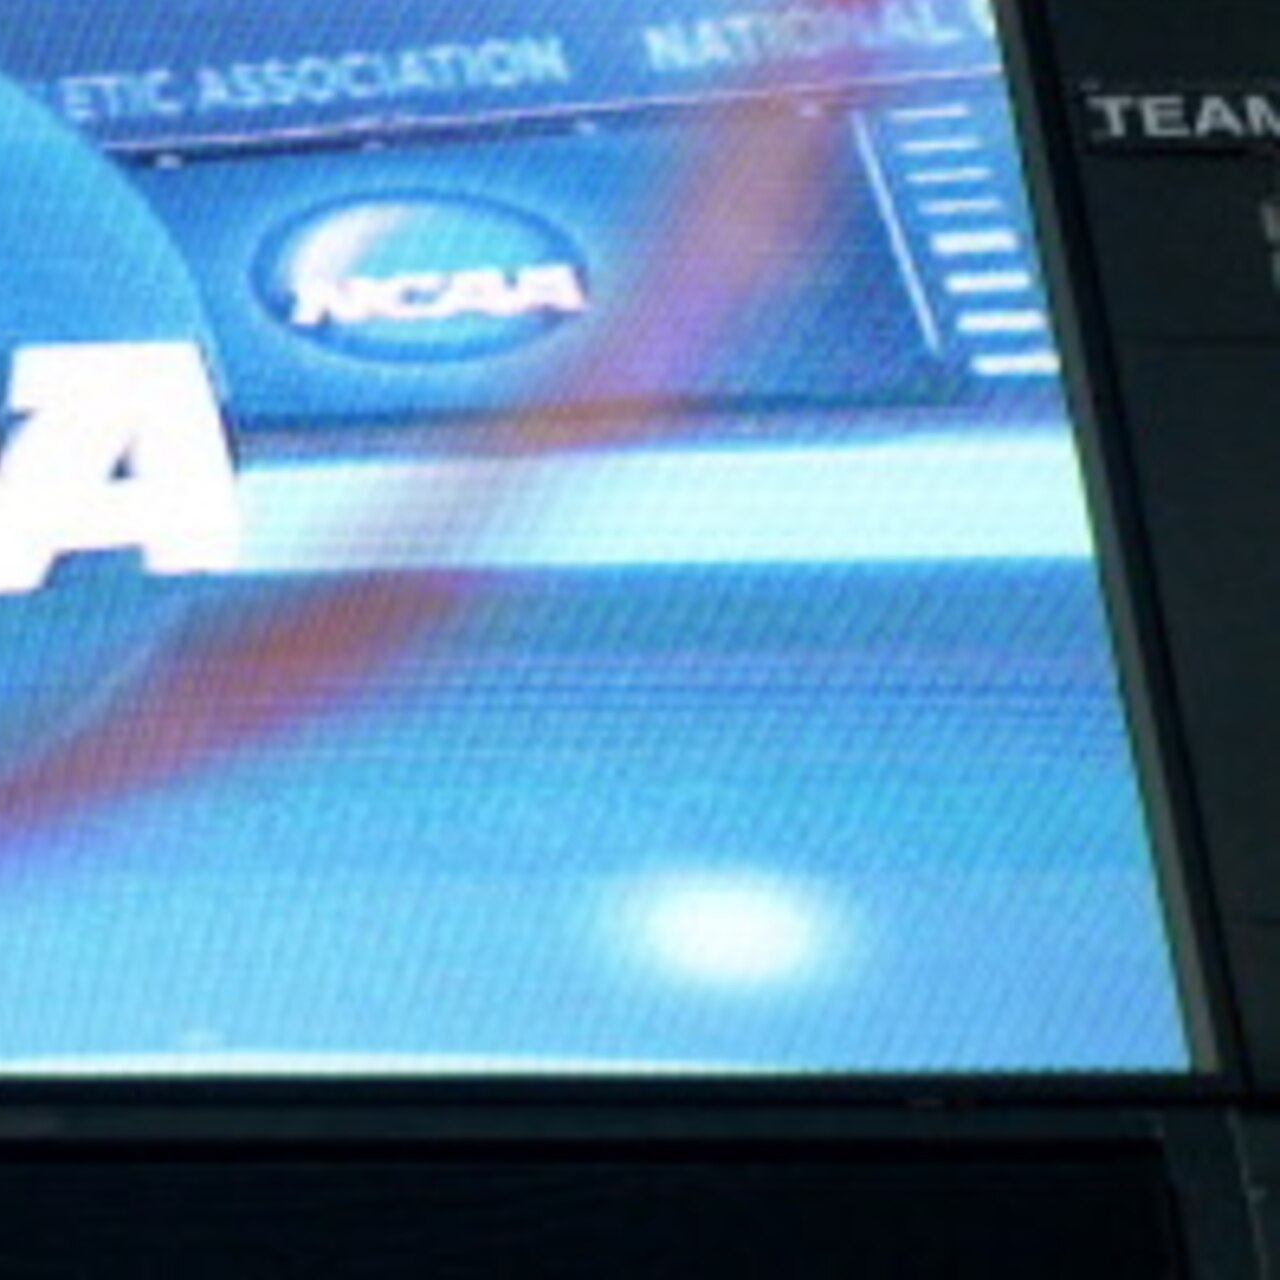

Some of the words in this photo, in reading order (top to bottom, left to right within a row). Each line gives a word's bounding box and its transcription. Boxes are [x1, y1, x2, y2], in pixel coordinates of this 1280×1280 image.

[57, 69, 185, 119] ETIC
[195, 36, 570, 114] ASSOCIATION
[288, 263, 591, 326] NCAA
